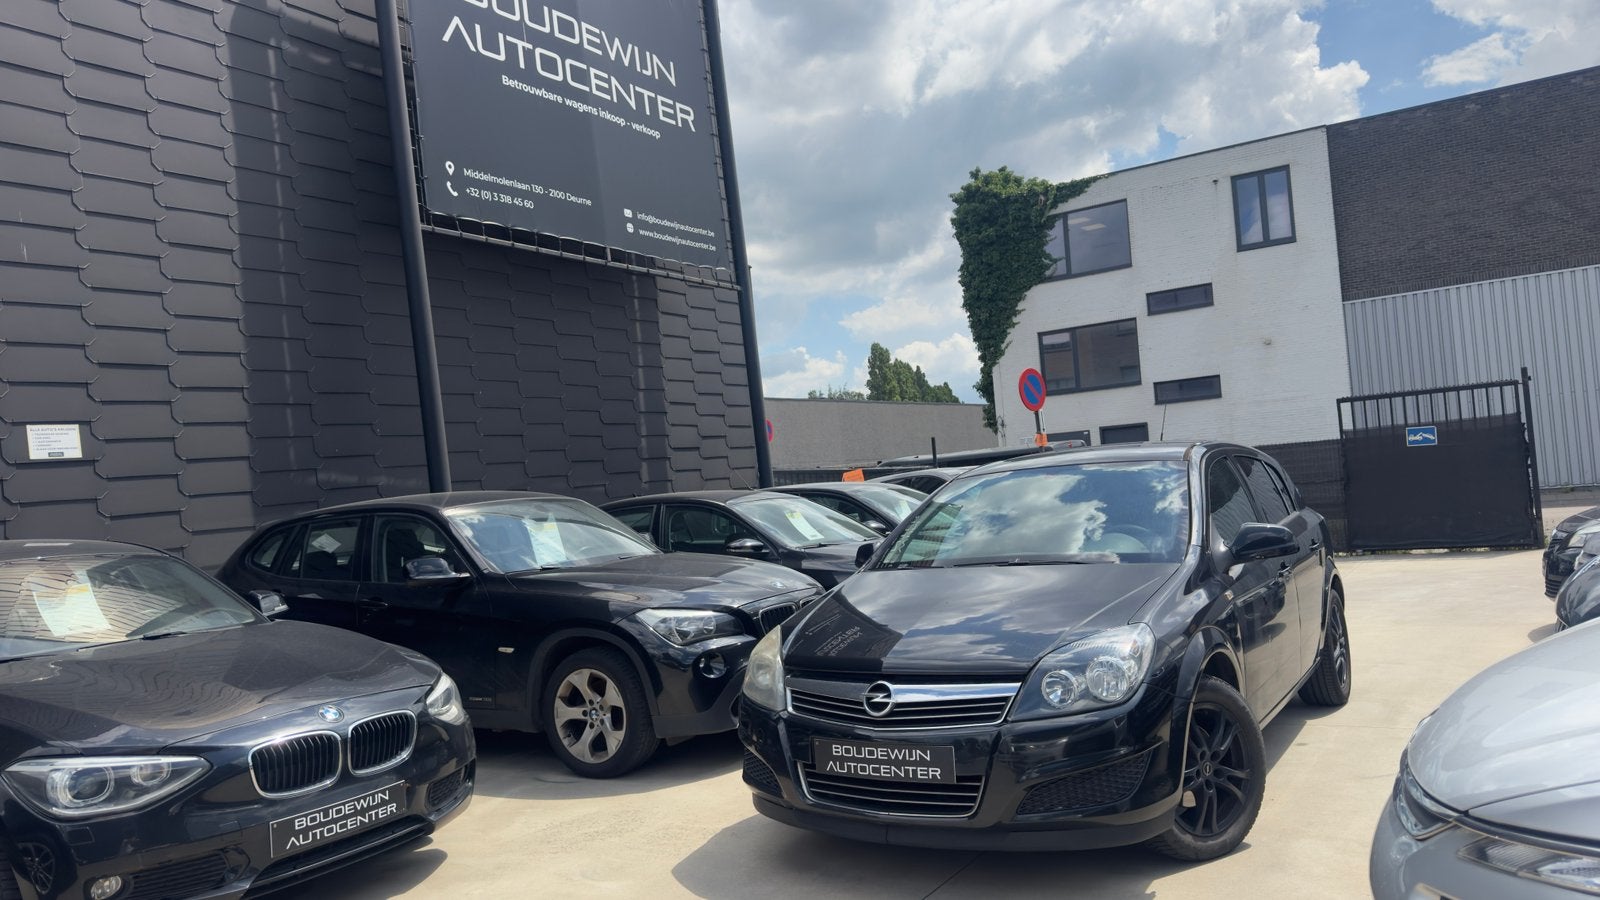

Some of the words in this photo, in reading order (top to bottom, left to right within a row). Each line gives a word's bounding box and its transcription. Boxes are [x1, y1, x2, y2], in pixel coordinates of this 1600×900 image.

[463, 0, 677, 87] OUDEWIJN
[442, 15, 696, 132] AUTOCENTER
[501, 74, 563, 104] Betrouwbare
[564, 96, 598, 116] wagens
[599, 107, 626, 127] inkoop
[631, 121, 661, 140] verkoop
[463, 167, 531, 191] Middelmolenlaan
[531, 183, 544, 194] 130
[549, 188, 566, 200] 2100
[566, 193, 592, 206] Deurne
[465, 187, 480, 198] +32
[481, 189, 492, 201] (0)
[493, 192, 499, 201] 3
[499, 193, 512, 204] 318
[513, 197, 523, 207] 45
[524, 199, 534, 209] 60
[636, 211, 715, 238] info@boudewijnautocenter.be
[638, 228, 717, 252] www.boudewijnautocenter.be
[826, 760, 941, 780] AUTOCENTER
[832, 744, 930, 761] BOUDEWIJN
[286, 803, 397, 850] AUTOCENTER
[294, 789, 389, 830] BOUDEWIJN
